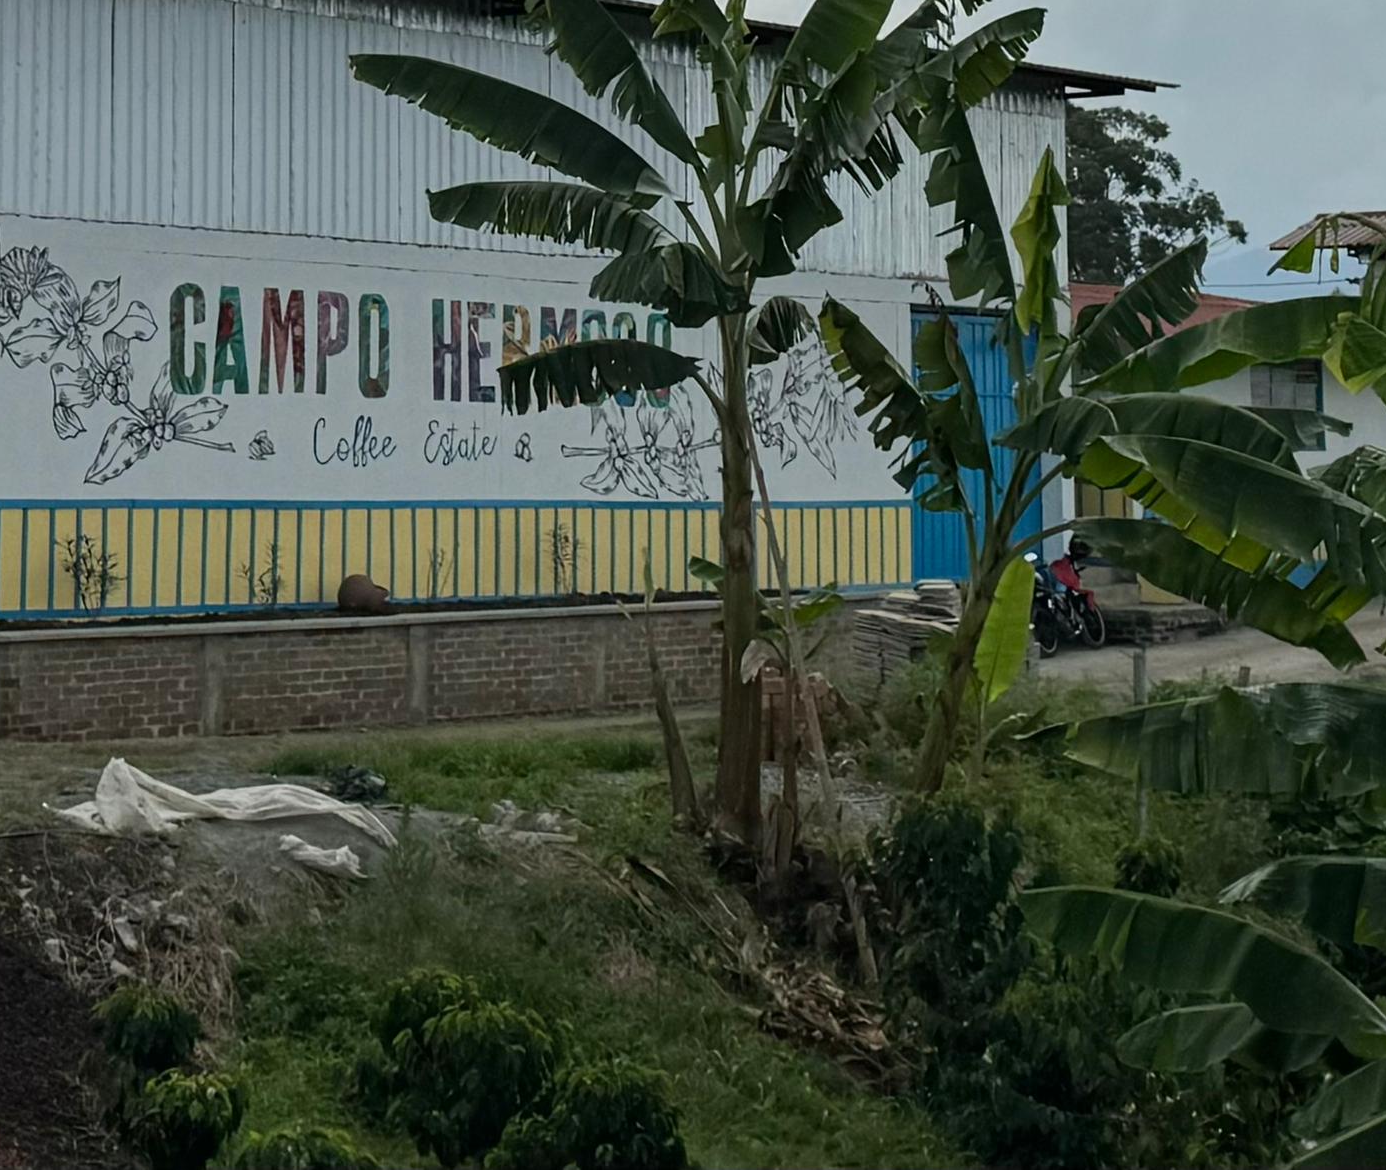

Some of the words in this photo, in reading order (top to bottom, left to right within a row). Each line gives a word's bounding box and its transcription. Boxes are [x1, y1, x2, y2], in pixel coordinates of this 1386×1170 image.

[169, 282, 390, 399] CAMPO
[313, 415, 397, 468] Coffee
[423, 419, 498, 466] Estate
